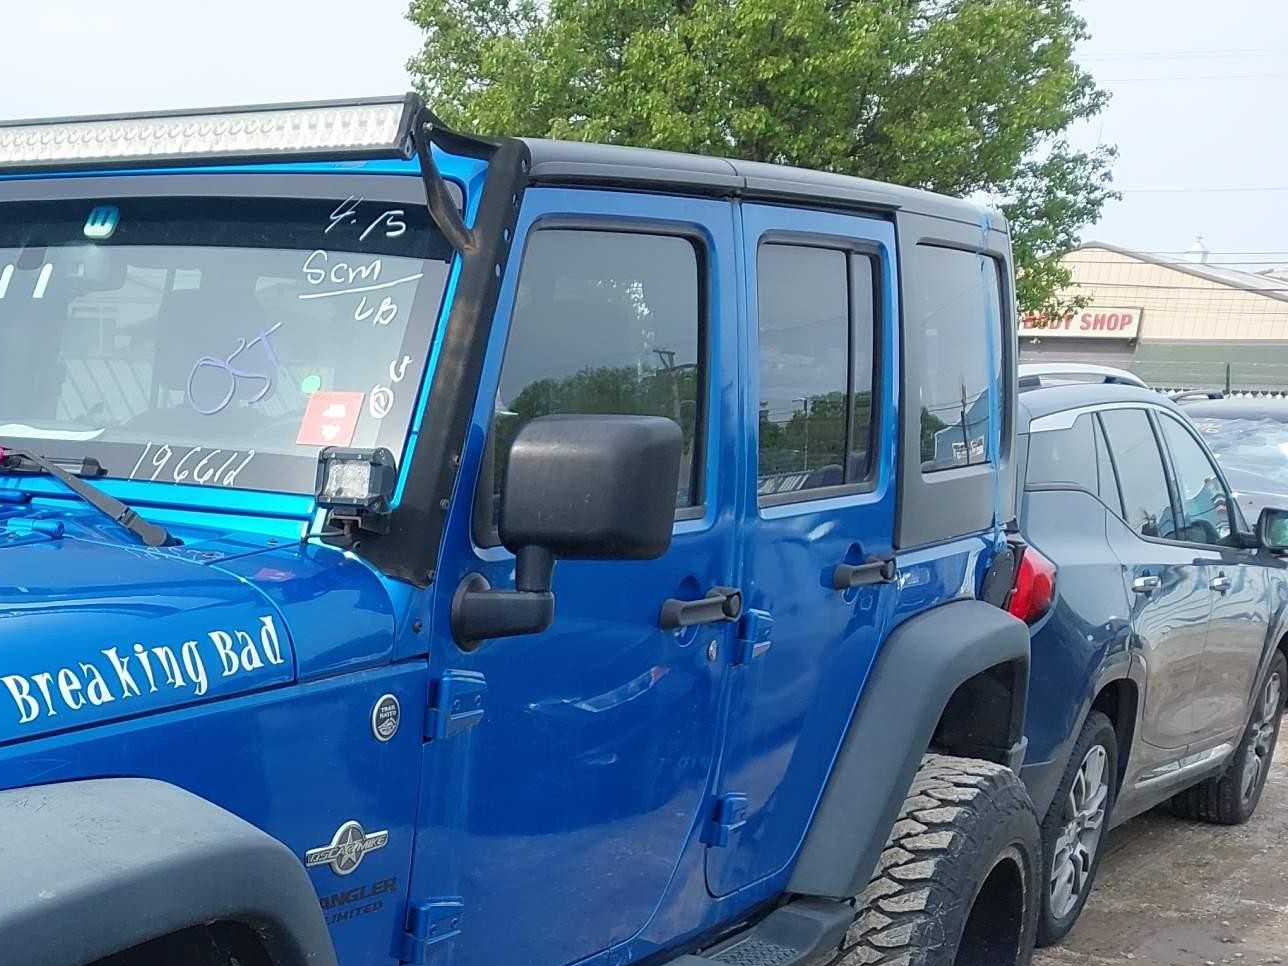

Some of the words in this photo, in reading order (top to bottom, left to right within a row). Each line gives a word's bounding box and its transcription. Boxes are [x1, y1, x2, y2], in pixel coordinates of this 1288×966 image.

[1079, 313, 1133, 331] SHOP
[0, 639, 210, 724] Breaking
[208, 615, 285, 677] Bad
[356, 835, 387, 852] MIKE
[320, 876, 398, 909] ANGLER
[326, 901, 383, 926] LIMITED
